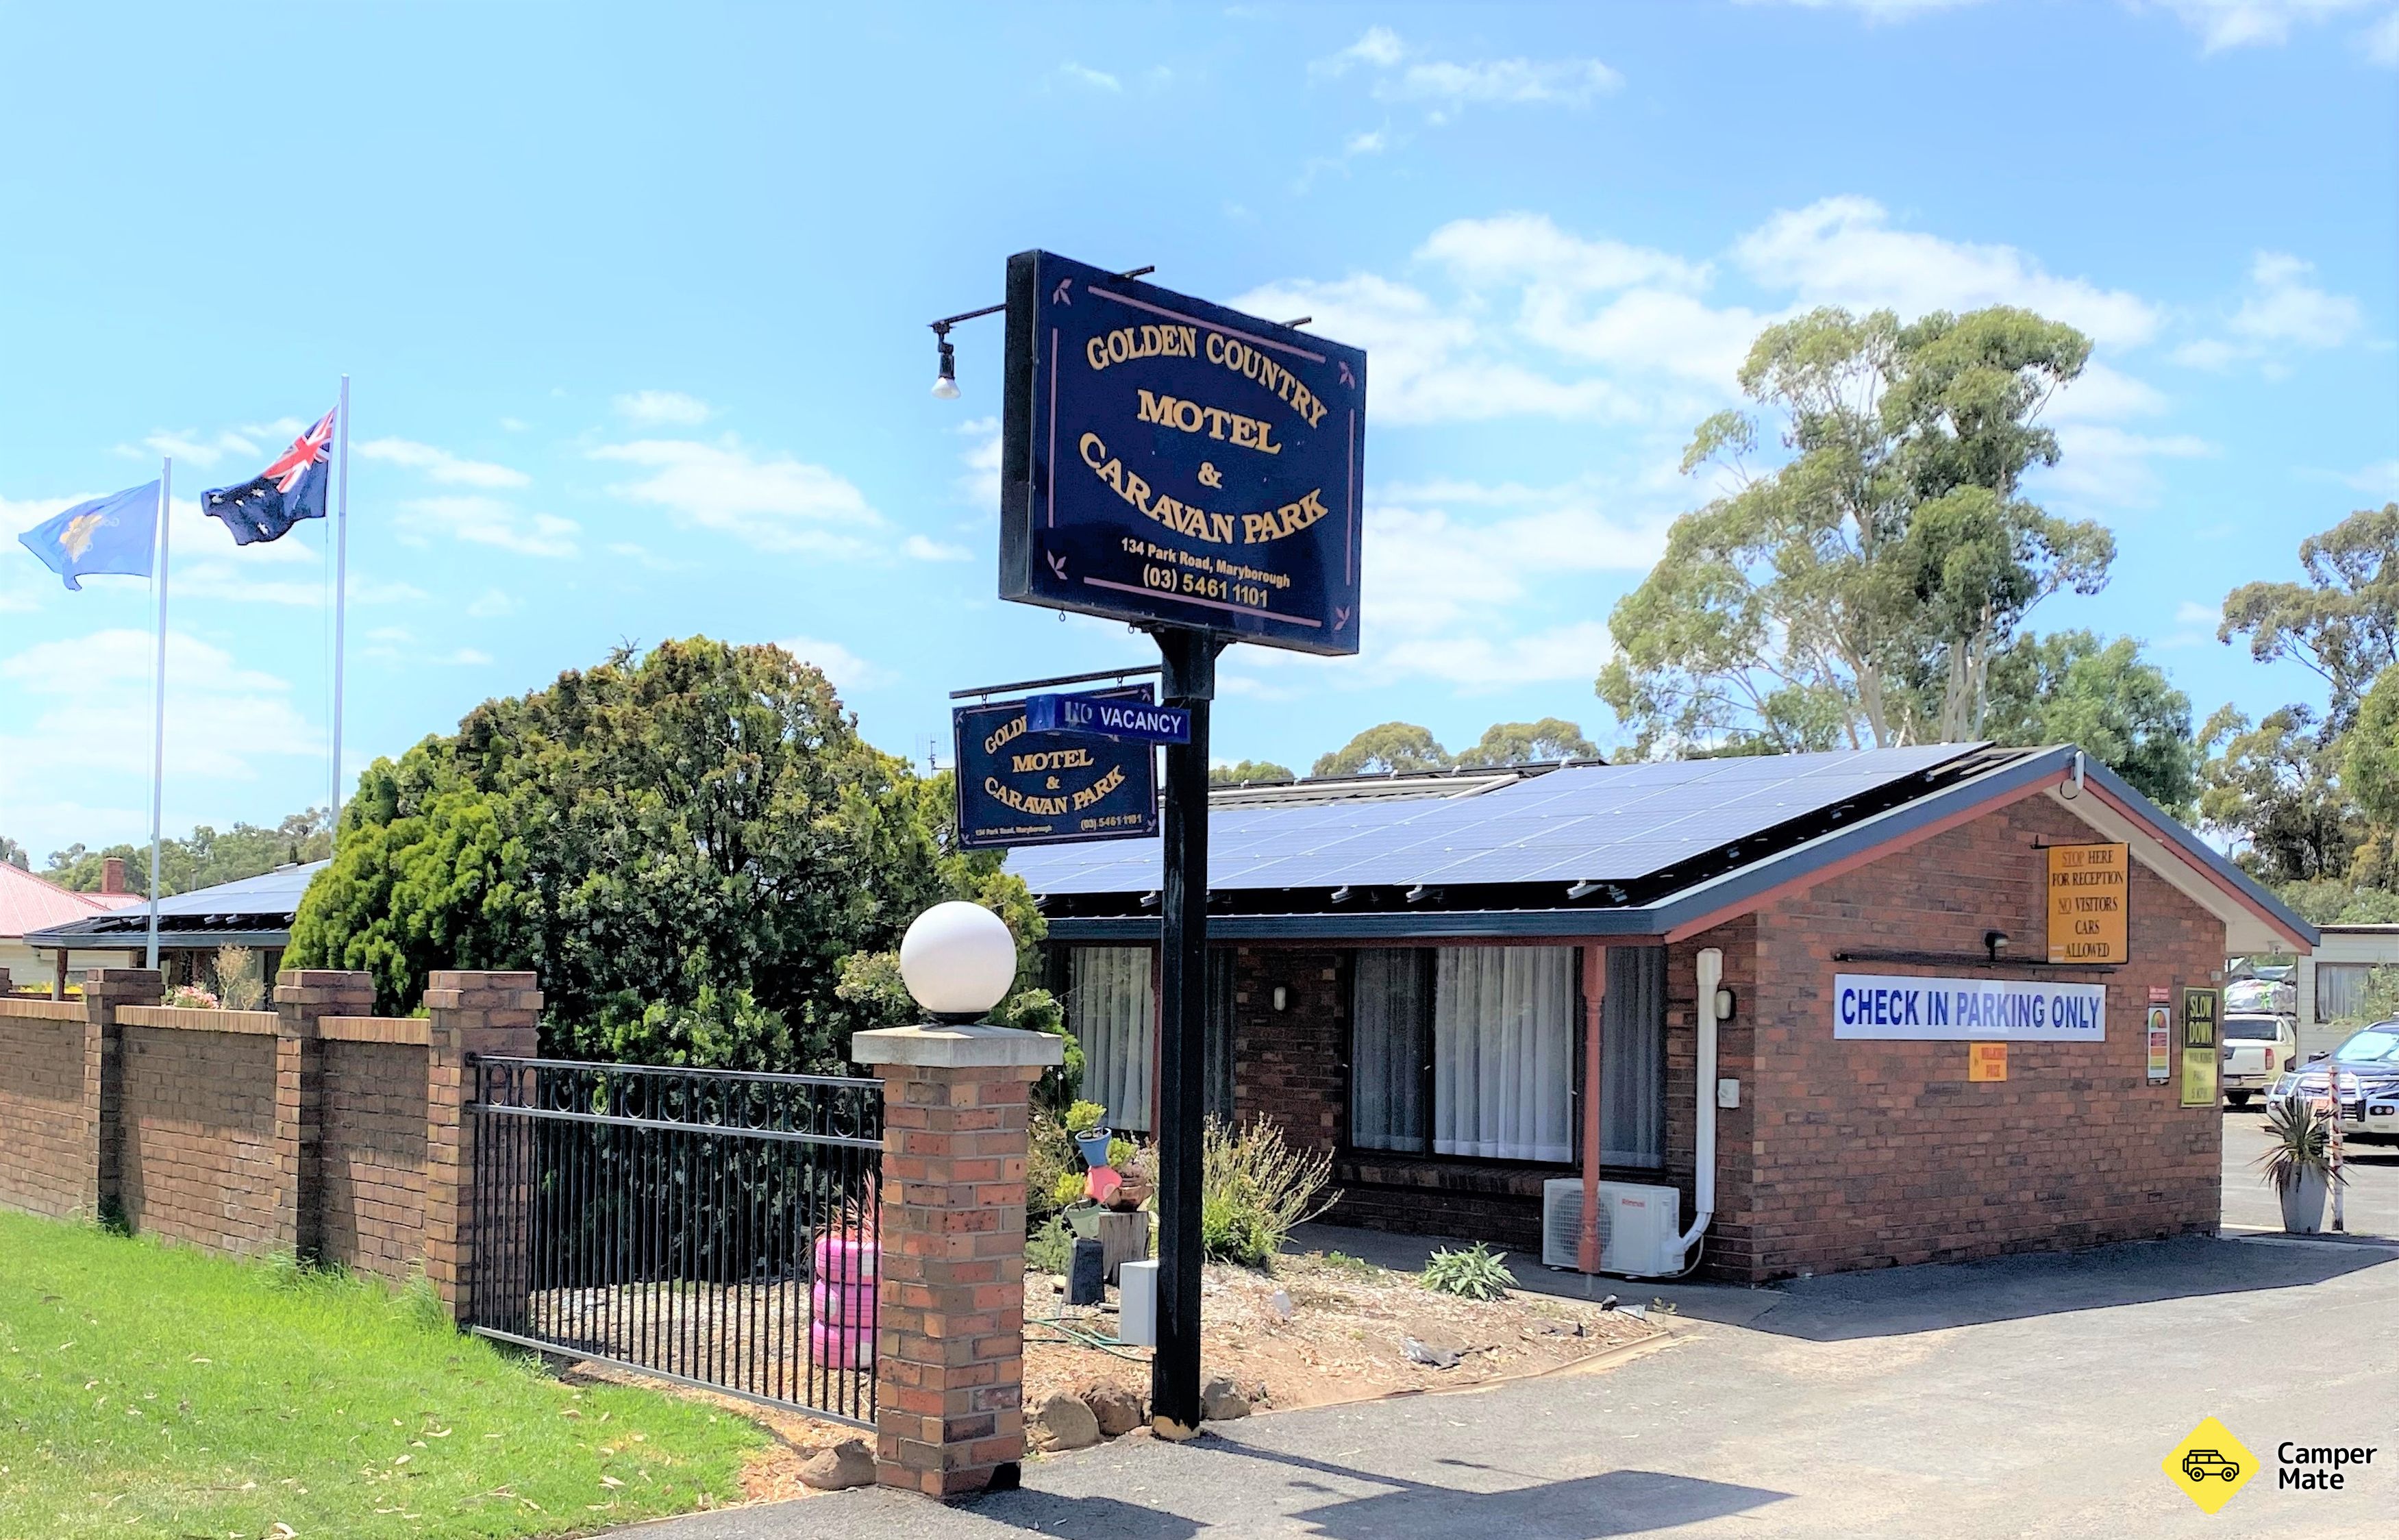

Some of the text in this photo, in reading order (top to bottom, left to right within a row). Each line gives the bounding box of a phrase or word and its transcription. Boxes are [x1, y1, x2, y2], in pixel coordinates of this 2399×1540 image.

[1086, 324, 1328, 428] GOLDEN COUNTRY
[1137, 388, 1282, 455] MOTEL
[1078, 432, 1329, 545] CARAVAN PARK
[1197, 462, 1223, 489] &
[1121, 537, 1291, 589] 134 Park Road, Maryborough
[1143, 563, 1268, 608] (03) 5461 1101
[1100, 706, 1182, 734] VACANCY
[984, 715, 1028, 754] GOLD
[1012, 748, 1095, 773] MOTEL
[984, 765, 1126, 815] CARAVAN PARK
[1046, 775, 1060, 790] &
[2062, 850, 2114, 866] STOP HERE
[2052, 870, 2124, 886] FOR RECEPTION
[2058, 897, 2118, 912] NO VISITORS
[2075, 919, 2100, 934] CARS
[2065, 942, 2110, 958] ALLOWED
[1842, 989, 2102, 1028] CHECK IN PARKING ONLY
[2189, 995, 2213, 1019] SLOW
[2189, 1021, 2213, 1044] DOWN
